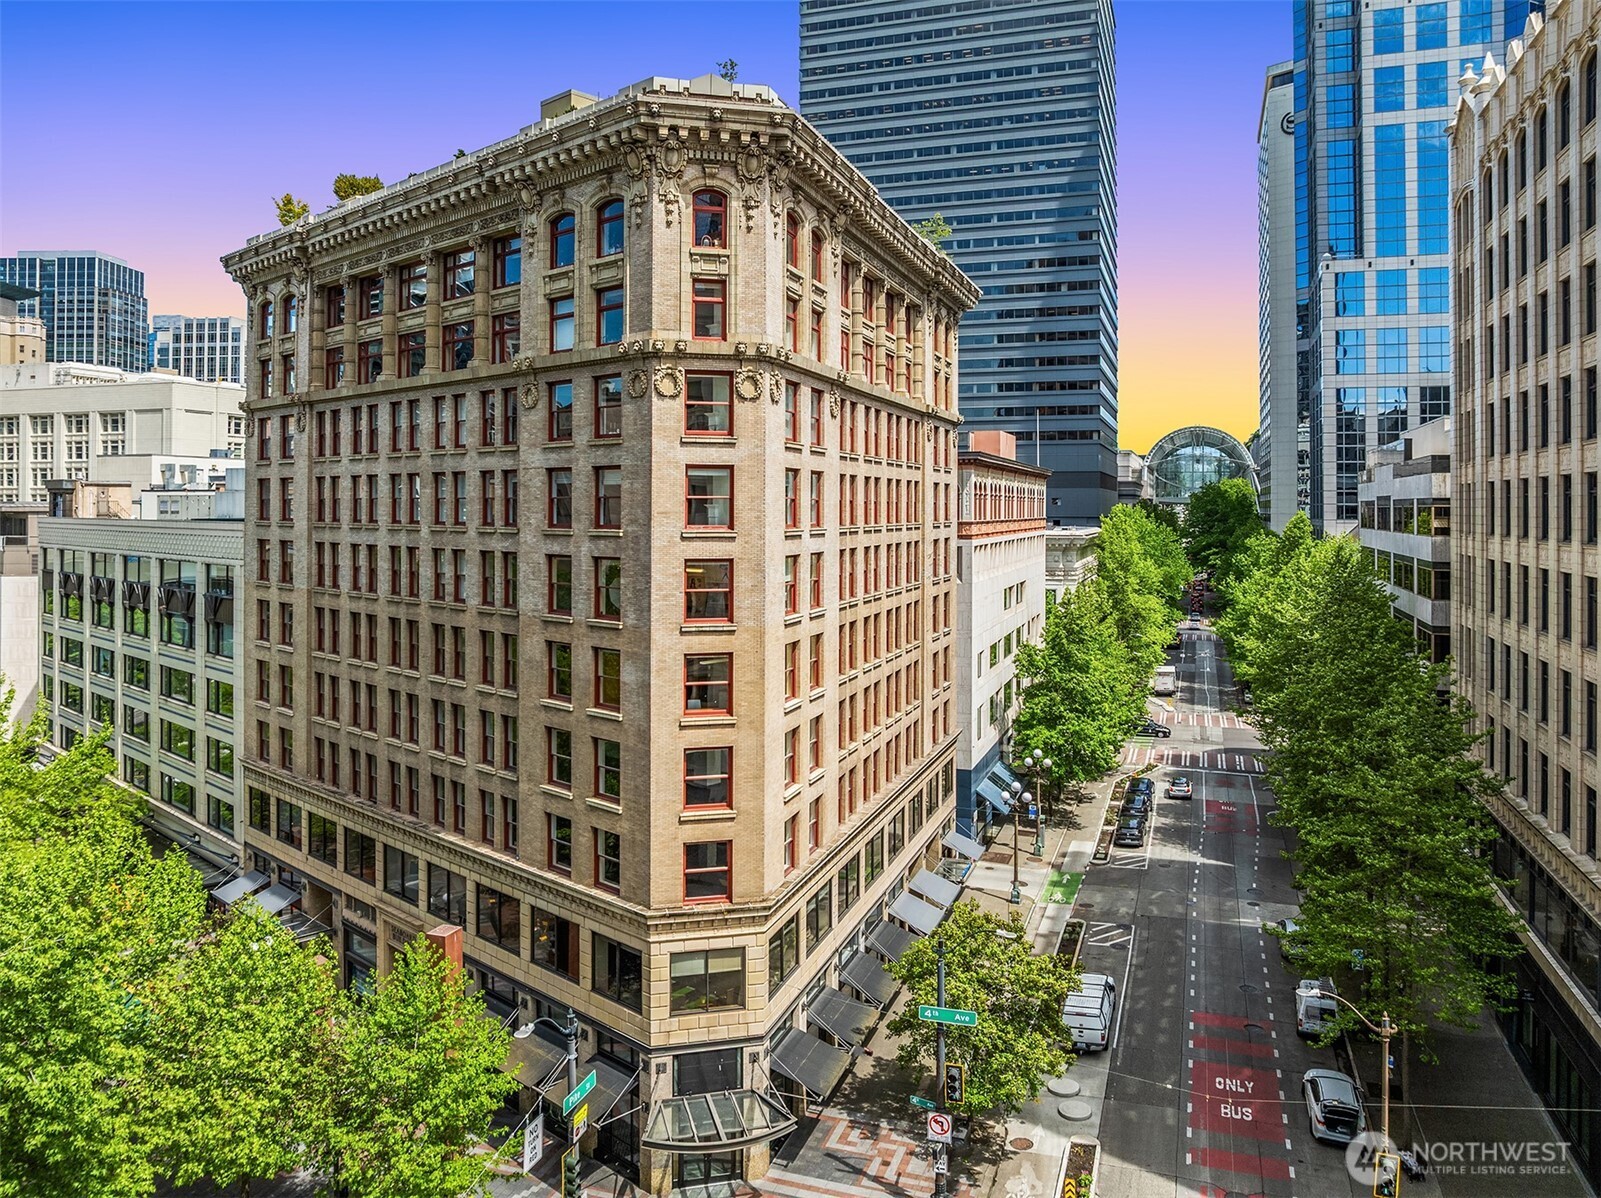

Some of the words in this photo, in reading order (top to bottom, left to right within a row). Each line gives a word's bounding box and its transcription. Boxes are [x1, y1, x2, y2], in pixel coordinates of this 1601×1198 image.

[924, 1009, 939, 1018] 4th
[954, 1013, 970, 1022] Ave
[1215, 1076, 1254, 1093] ONLY
[569, 1091, 581, 1107] Pike
[1221, 1103, 1253, 1121] BUS
[529, 1123, 539, 1138] NO
[528, 1133, 540, 1148] TURN
[529, 1144, 537, 1154] ON
[529, 1152, 538, 1164] RED
